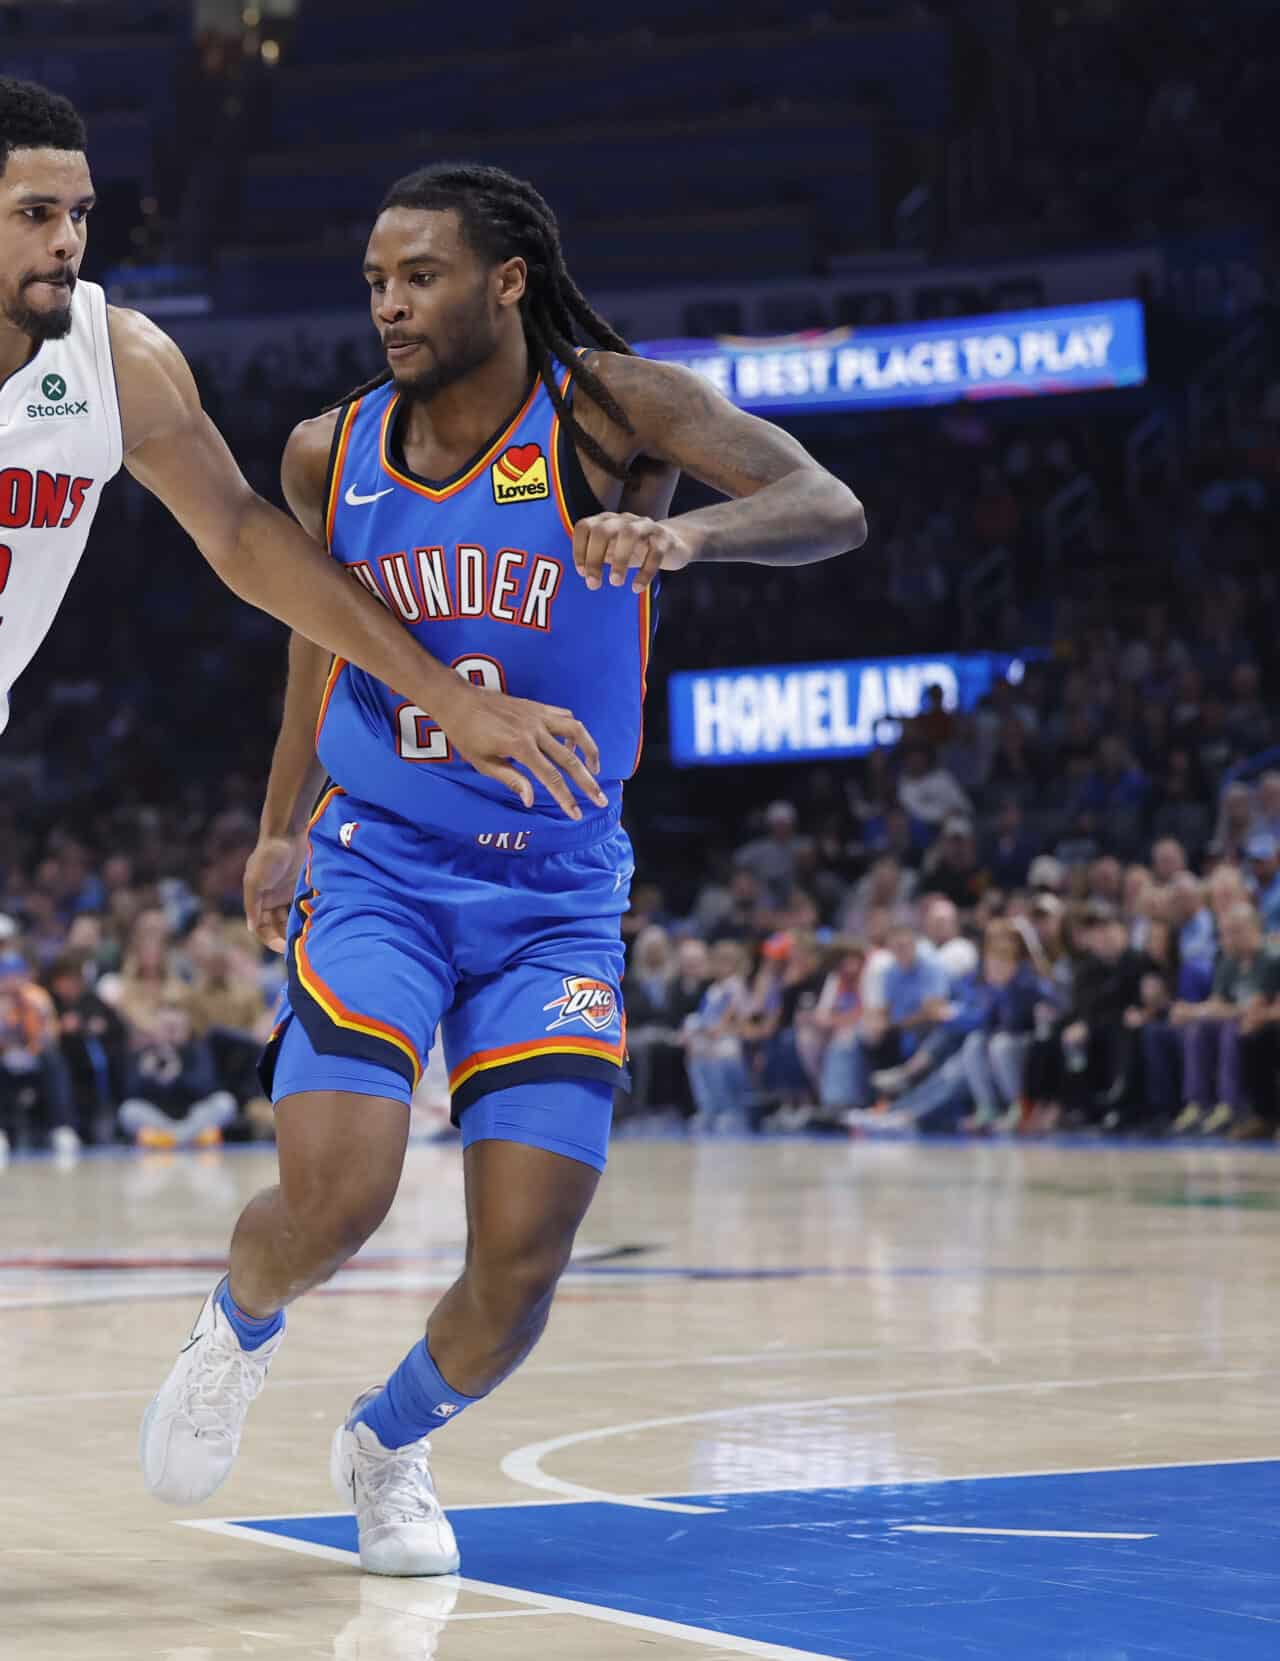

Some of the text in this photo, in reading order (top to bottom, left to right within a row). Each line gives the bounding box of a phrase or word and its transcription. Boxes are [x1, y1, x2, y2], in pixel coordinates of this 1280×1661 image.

[736, 348, 832, 398] BEST
[837, 338, 960, 390] PLACE
[963, 332, 1017, 378] TO
[1019, 322, 1114, 375] PLAY
[26, 400, 89, 418] StockX
[563, 988, 612, 1016] OKC
